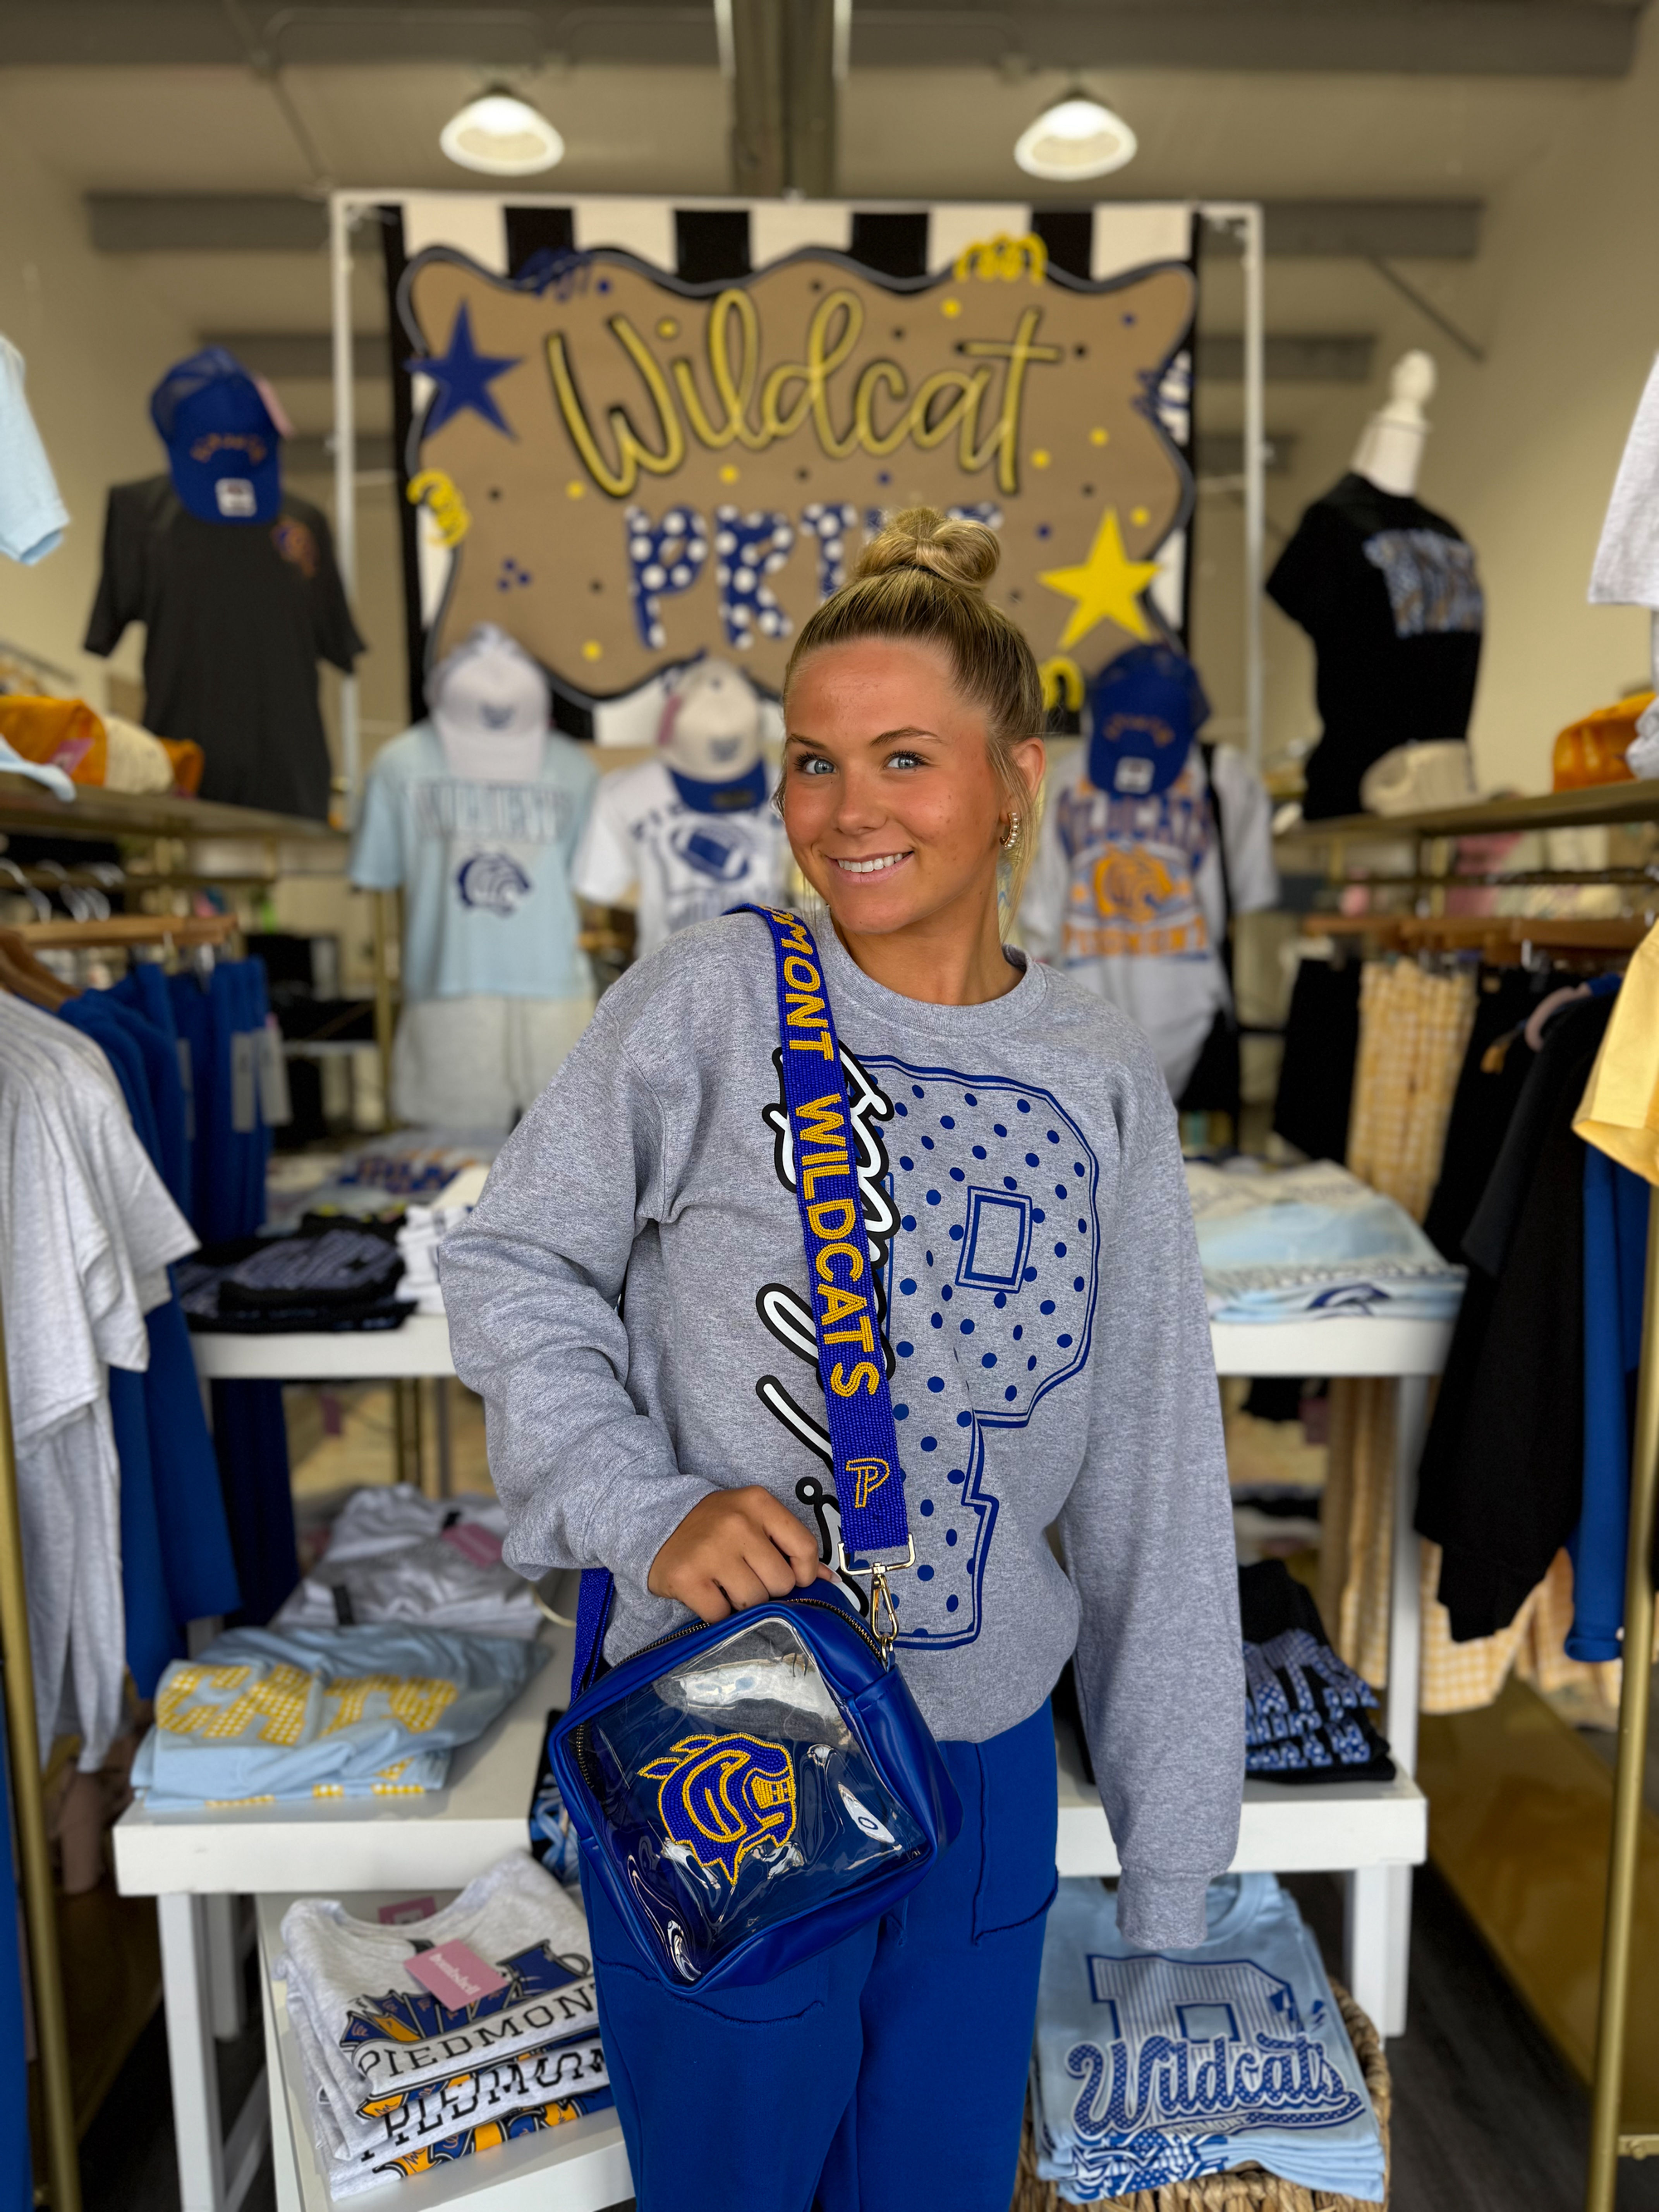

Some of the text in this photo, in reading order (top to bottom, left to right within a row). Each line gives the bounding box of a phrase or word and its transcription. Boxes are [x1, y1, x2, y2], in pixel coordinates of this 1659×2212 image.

[547, 289, 1061, 498] Wildcat
[624, 503, 1004, 648] PRI
[795, 1093, 881, 1398] WILDCATS
[845, 1456, 890, 1508] P
[359, 1984, 599, 2081] PIEDMON
[1066, 2032, 1366, 2144] Wildcats
